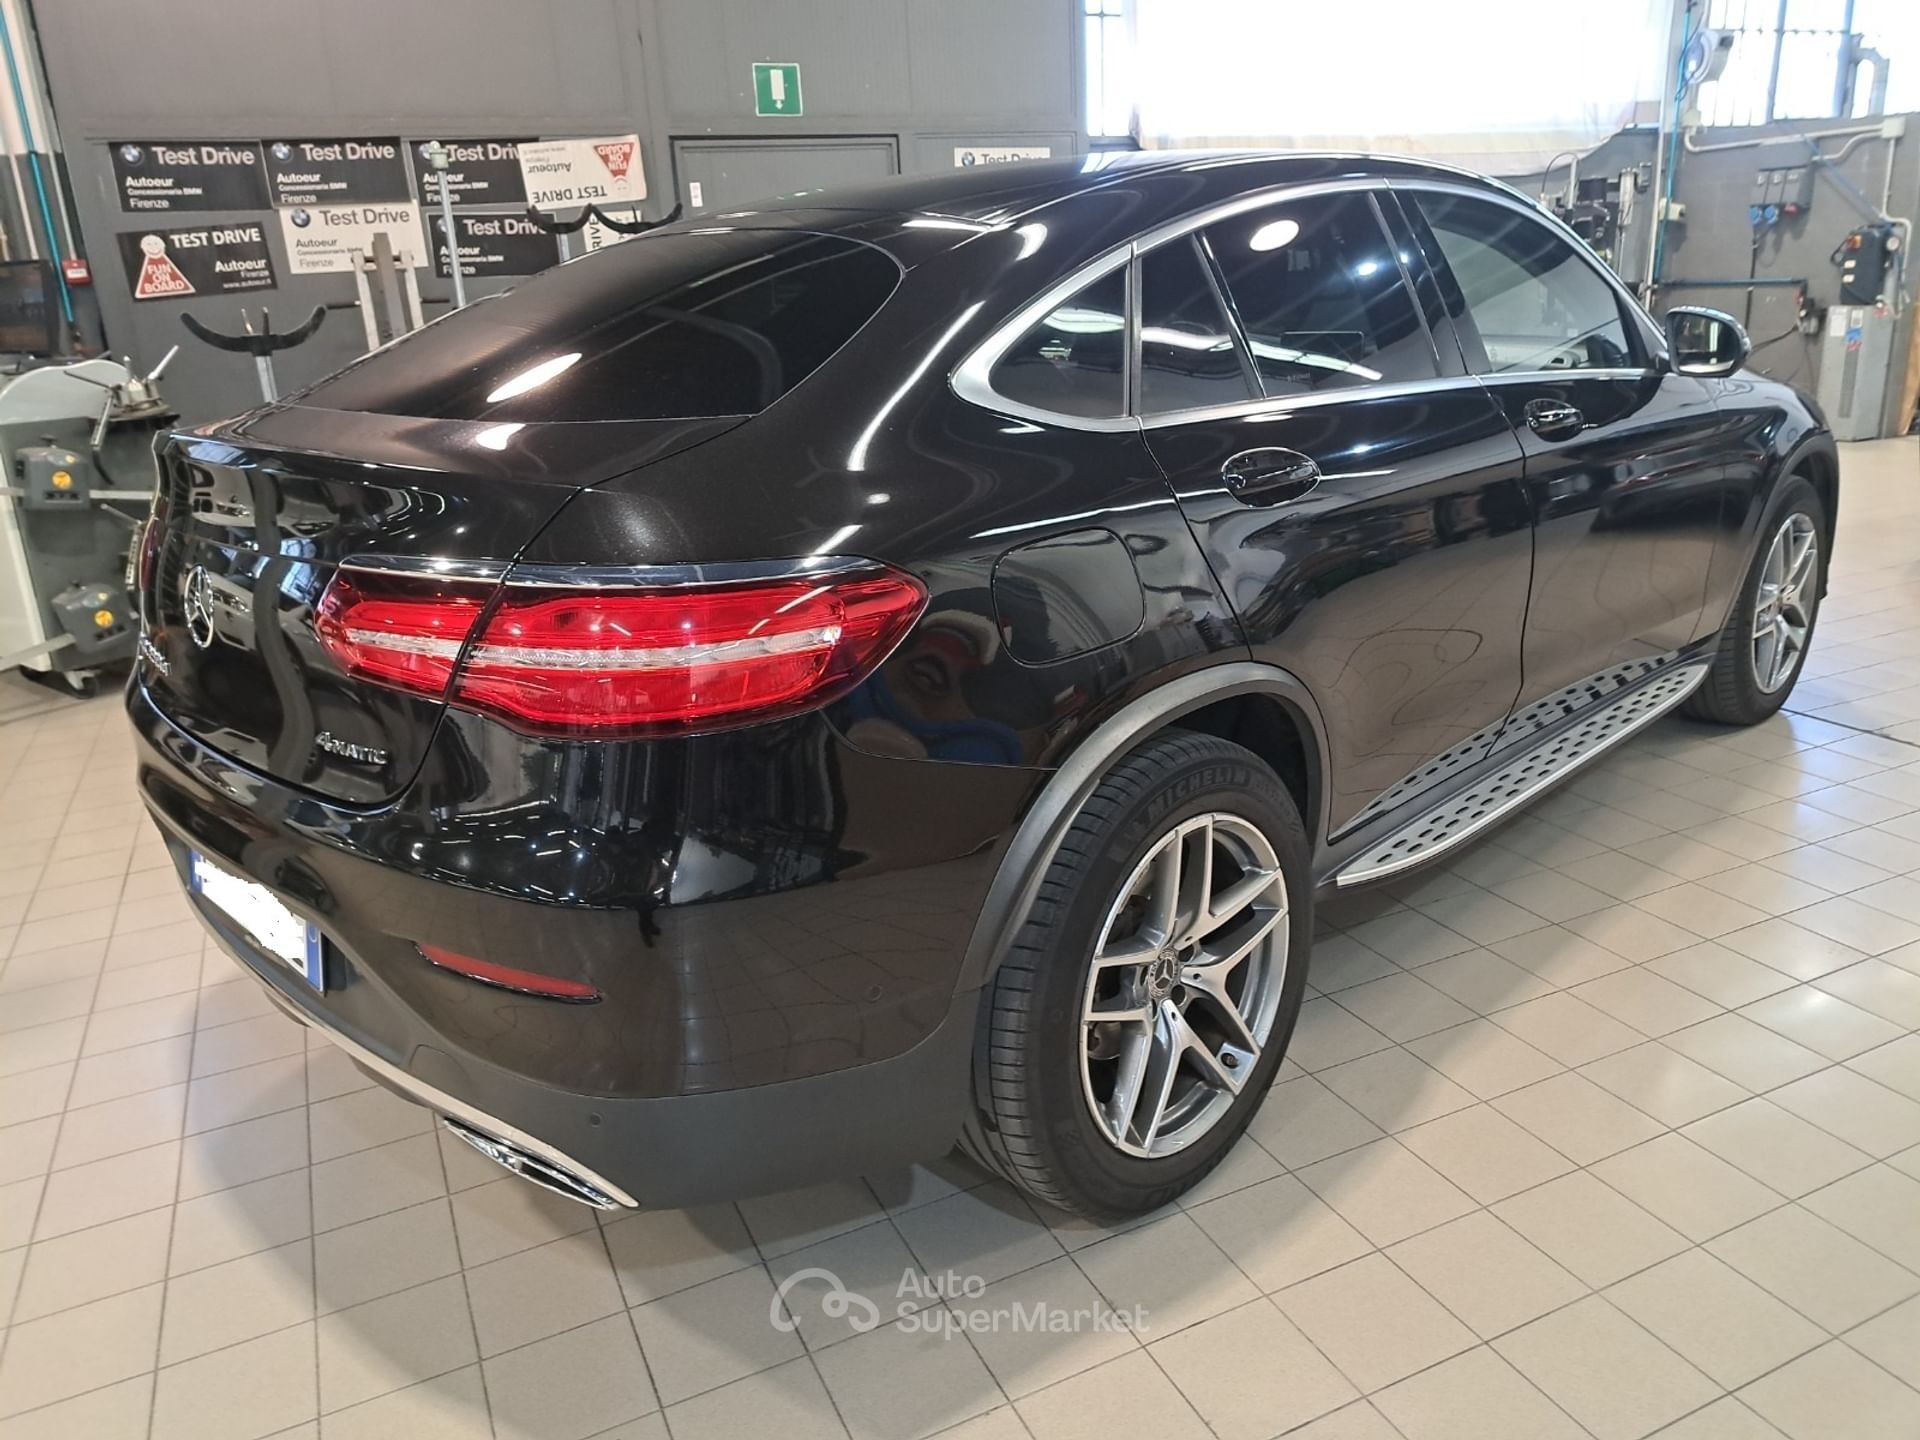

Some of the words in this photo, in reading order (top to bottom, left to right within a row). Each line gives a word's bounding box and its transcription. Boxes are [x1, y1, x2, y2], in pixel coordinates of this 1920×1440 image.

[300, 143, 343, 161] Test
[345, 142, 395, 160] Drive
[445, 144, 485, 161] Test
[487, 143, 519, 160] Driv
[597, 144, 630, 155] BOARD
[152, 146, 198, 165] Test
[201, 147, 255, 165] Drive
[609, 153, 624, 161] ON
[528, 161, 572, 174] Autoeur
[126, 176, 174, 187] Autoeur
[277, 172, 321, 183] Autoeur
[423, 173, 464, 183] Aueur
[280, 193, 317, 203] Firenze
[532, 190, 573, 204] DRIVE
[576, 185, 608, 200] TEST
[129, 197, 170, 208] Firenze
[318, 209, 359, 226] Test
[363, 207, 410, 224] Drive
[462, 219, 501, 235] Test
[170, 232, 209, 248] TEST
[212, 228, 261, 245] DRIVE
[296, 238, 337, 248] Autoeur
[440, 245, 481, 255] Aoeur
[214, 258, 267, 272] Autoeur
[299, 257, 334, 268] Firenze
[147, 264, 172, 274] FUN
[152, 273, 171, 283] ON
[144, 280, 185, 293] BOARD
